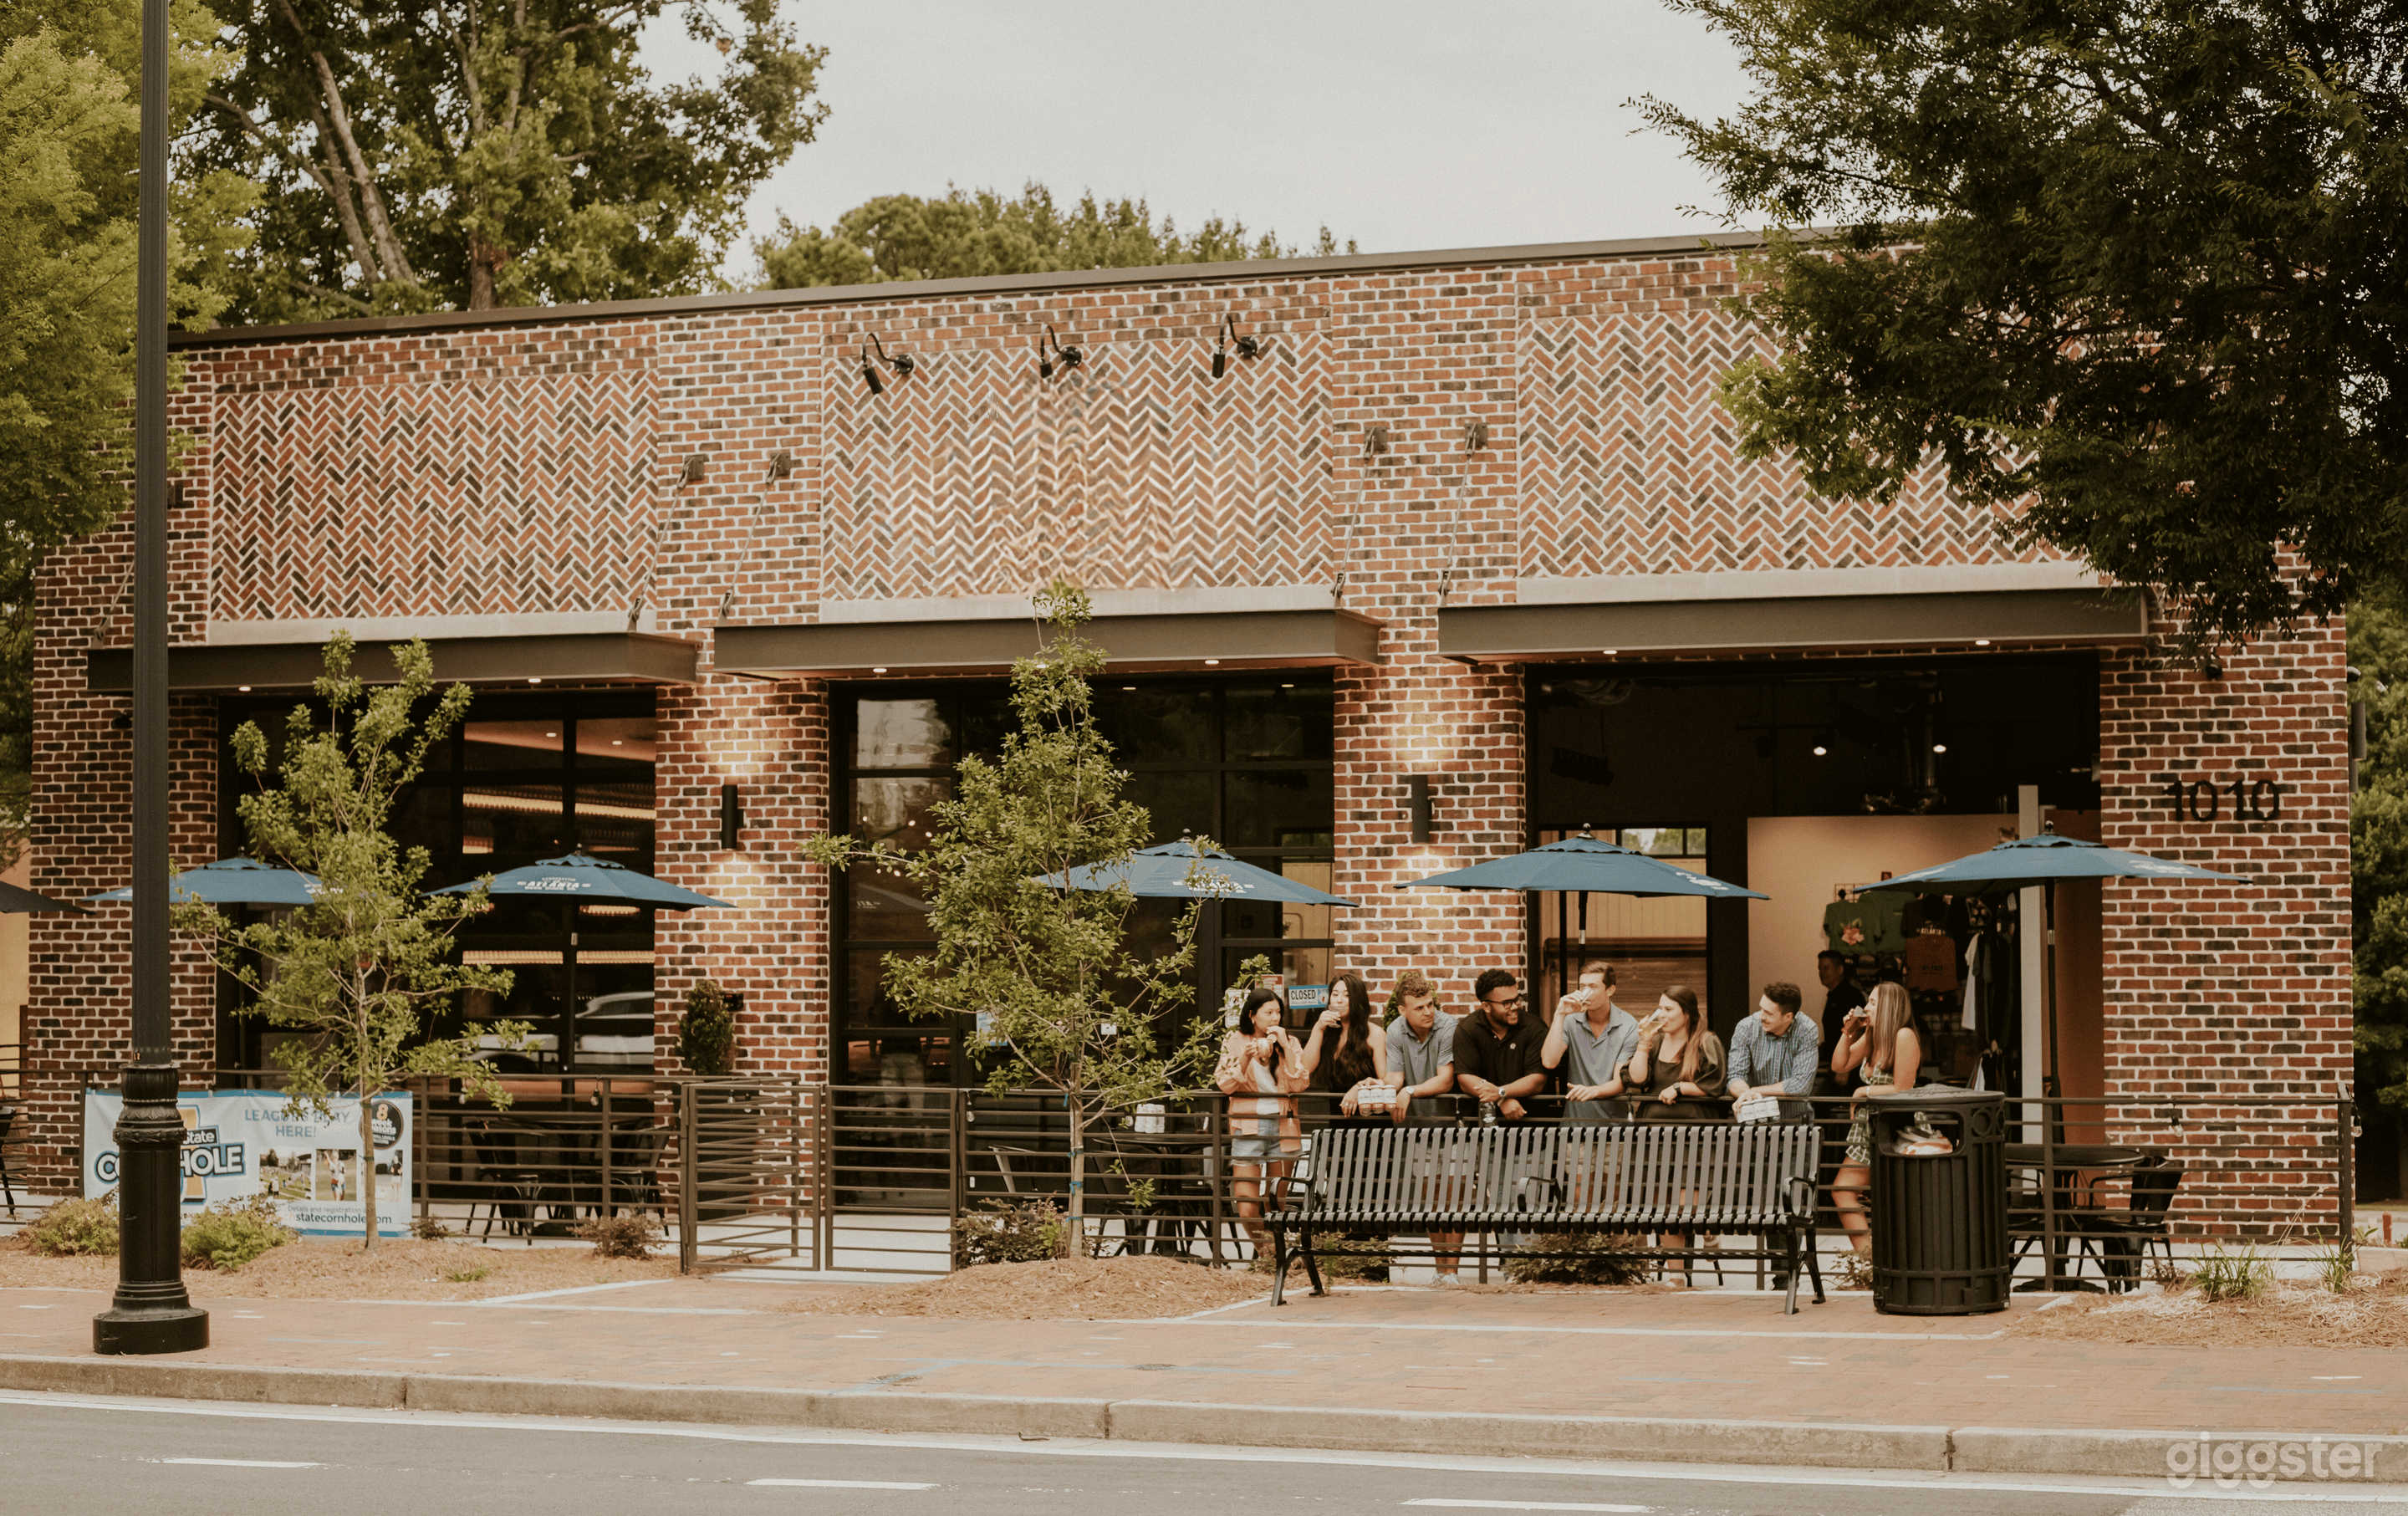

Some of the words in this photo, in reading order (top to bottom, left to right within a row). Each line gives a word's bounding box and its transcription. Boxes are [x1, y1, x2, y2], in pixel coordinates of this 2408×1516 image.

[2163, 779, 2280, 822] 1010
[1291, 989, 1316, 1000] CLOSED
[376, 1103, 388, 1120] 8
[276, 1125, 317, 1137] HERE!
